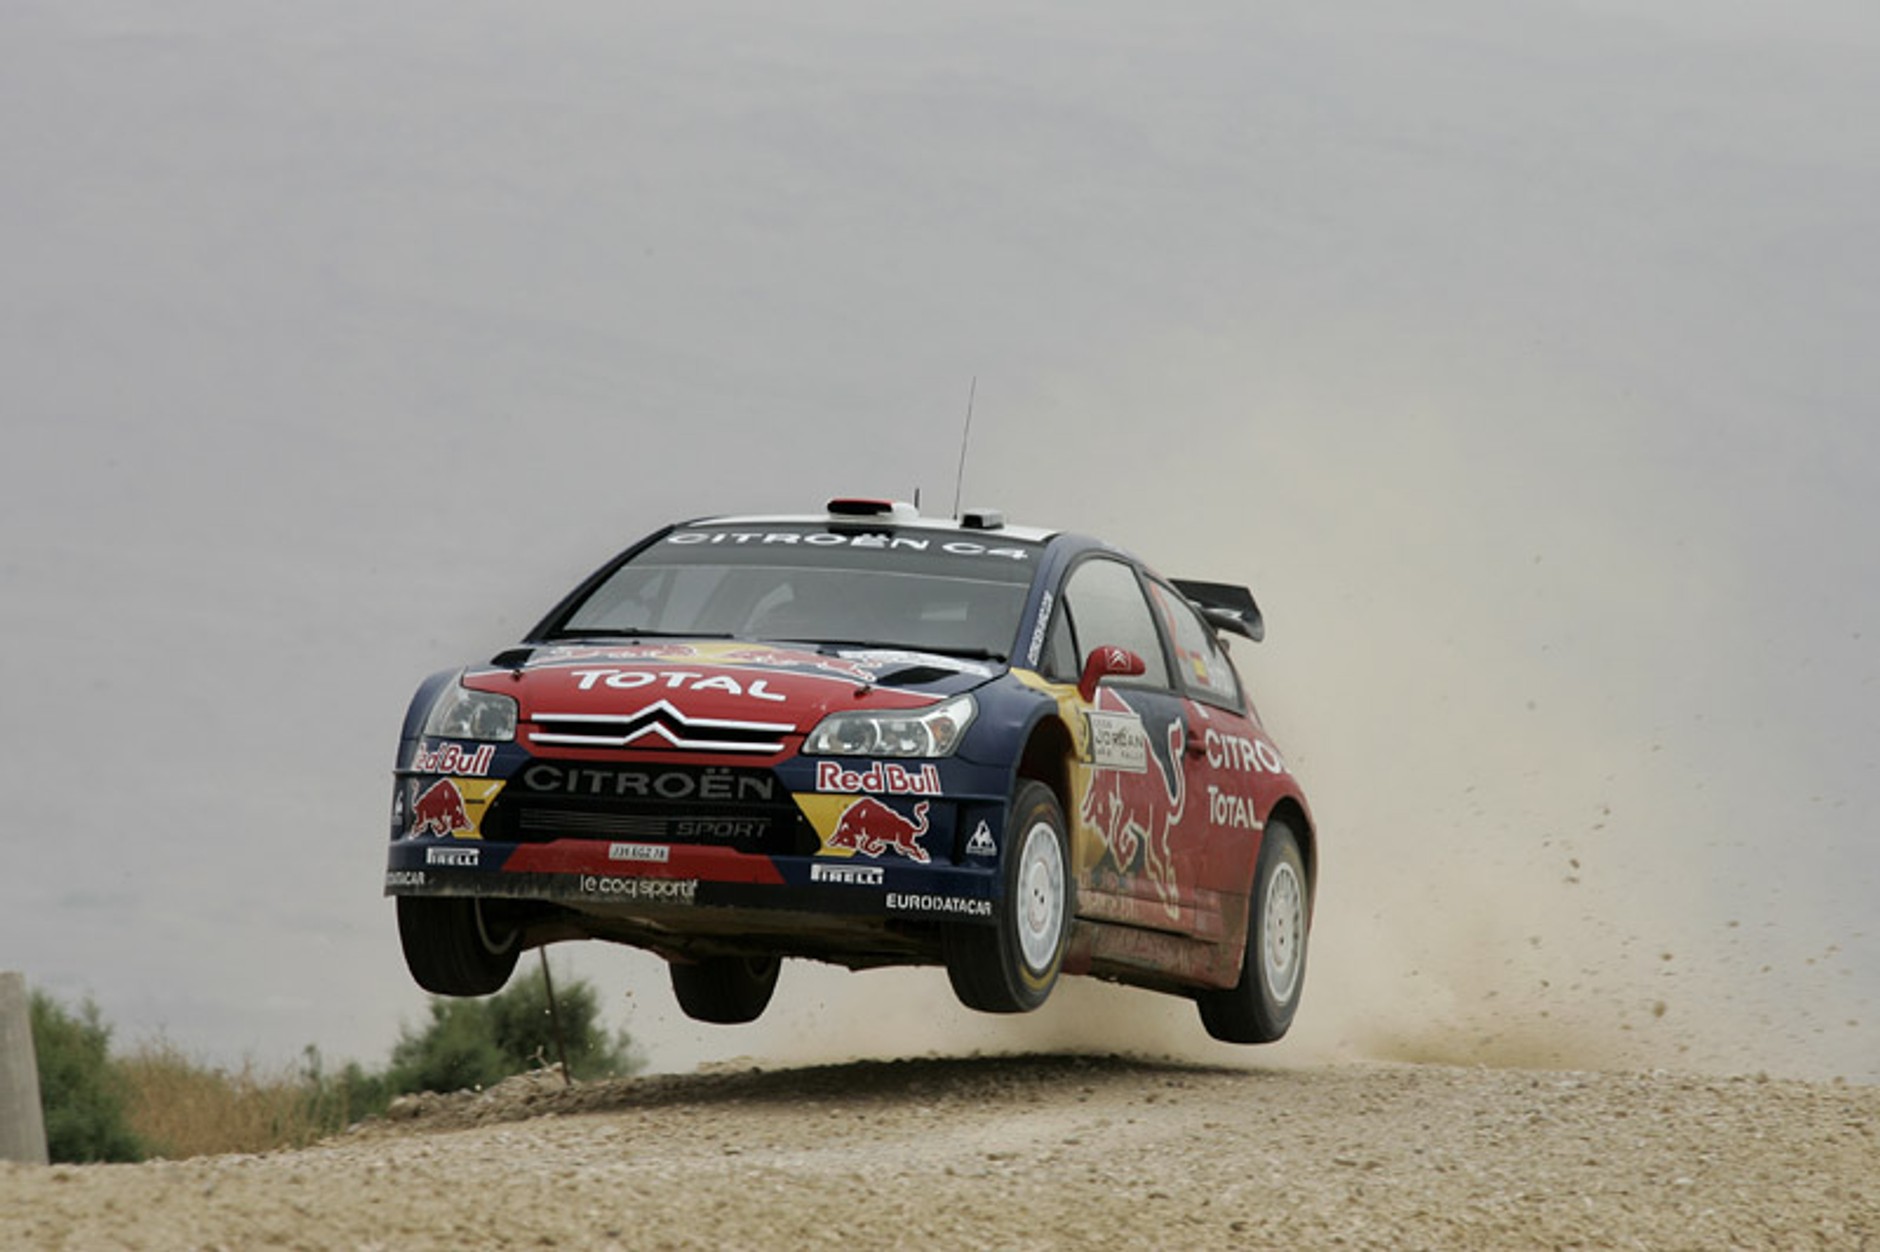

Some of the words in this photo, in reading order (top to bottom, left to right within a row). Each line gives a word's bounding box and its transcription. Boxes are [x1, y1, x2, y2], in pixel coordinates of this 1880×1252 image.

[667, 532, 929, 550] CITROËN
[941, 541, 1029, 560] C4
[571, 669, 787, 701] TOTAL
[438, 745, 496, 776] Bull
[1205, 728, 1284, 774] CITRO
[524, 765, 774, 800] CITROËN
[816, 761, 884, 792] Red
[884, 763, 943, 795] Bull
[1207, 784, 1264, 831] TOTAL
[676, 819, 768, 839] SPORT
[426, 848, 480, 866] PIRELLI
[580, 874, 597, 894] le
[600, 877, 638, 899] coq
[640, 878, 698, 899] sportif
[810, 863, 885, 886] PIRELLI
[885, 892, 992, 916] EURODATACAR
